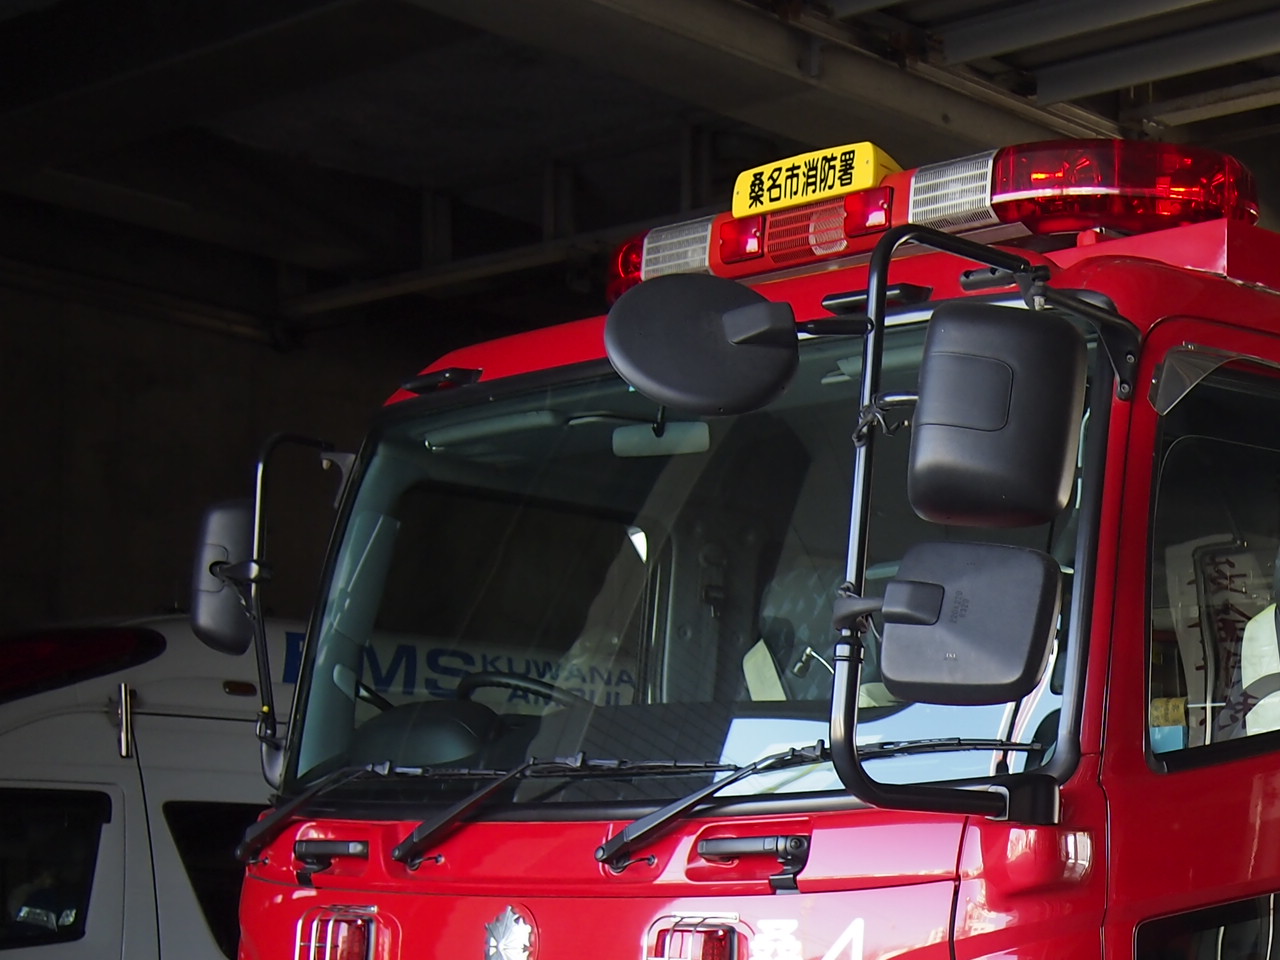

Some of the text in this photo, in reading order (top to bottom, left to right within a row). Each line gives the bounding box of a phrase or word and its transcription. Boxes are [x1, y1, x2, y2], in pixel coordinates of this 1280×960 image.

[748, 150, 856, 209] 桑名市消防署
[481, 653, 635, 688] KUWANA
